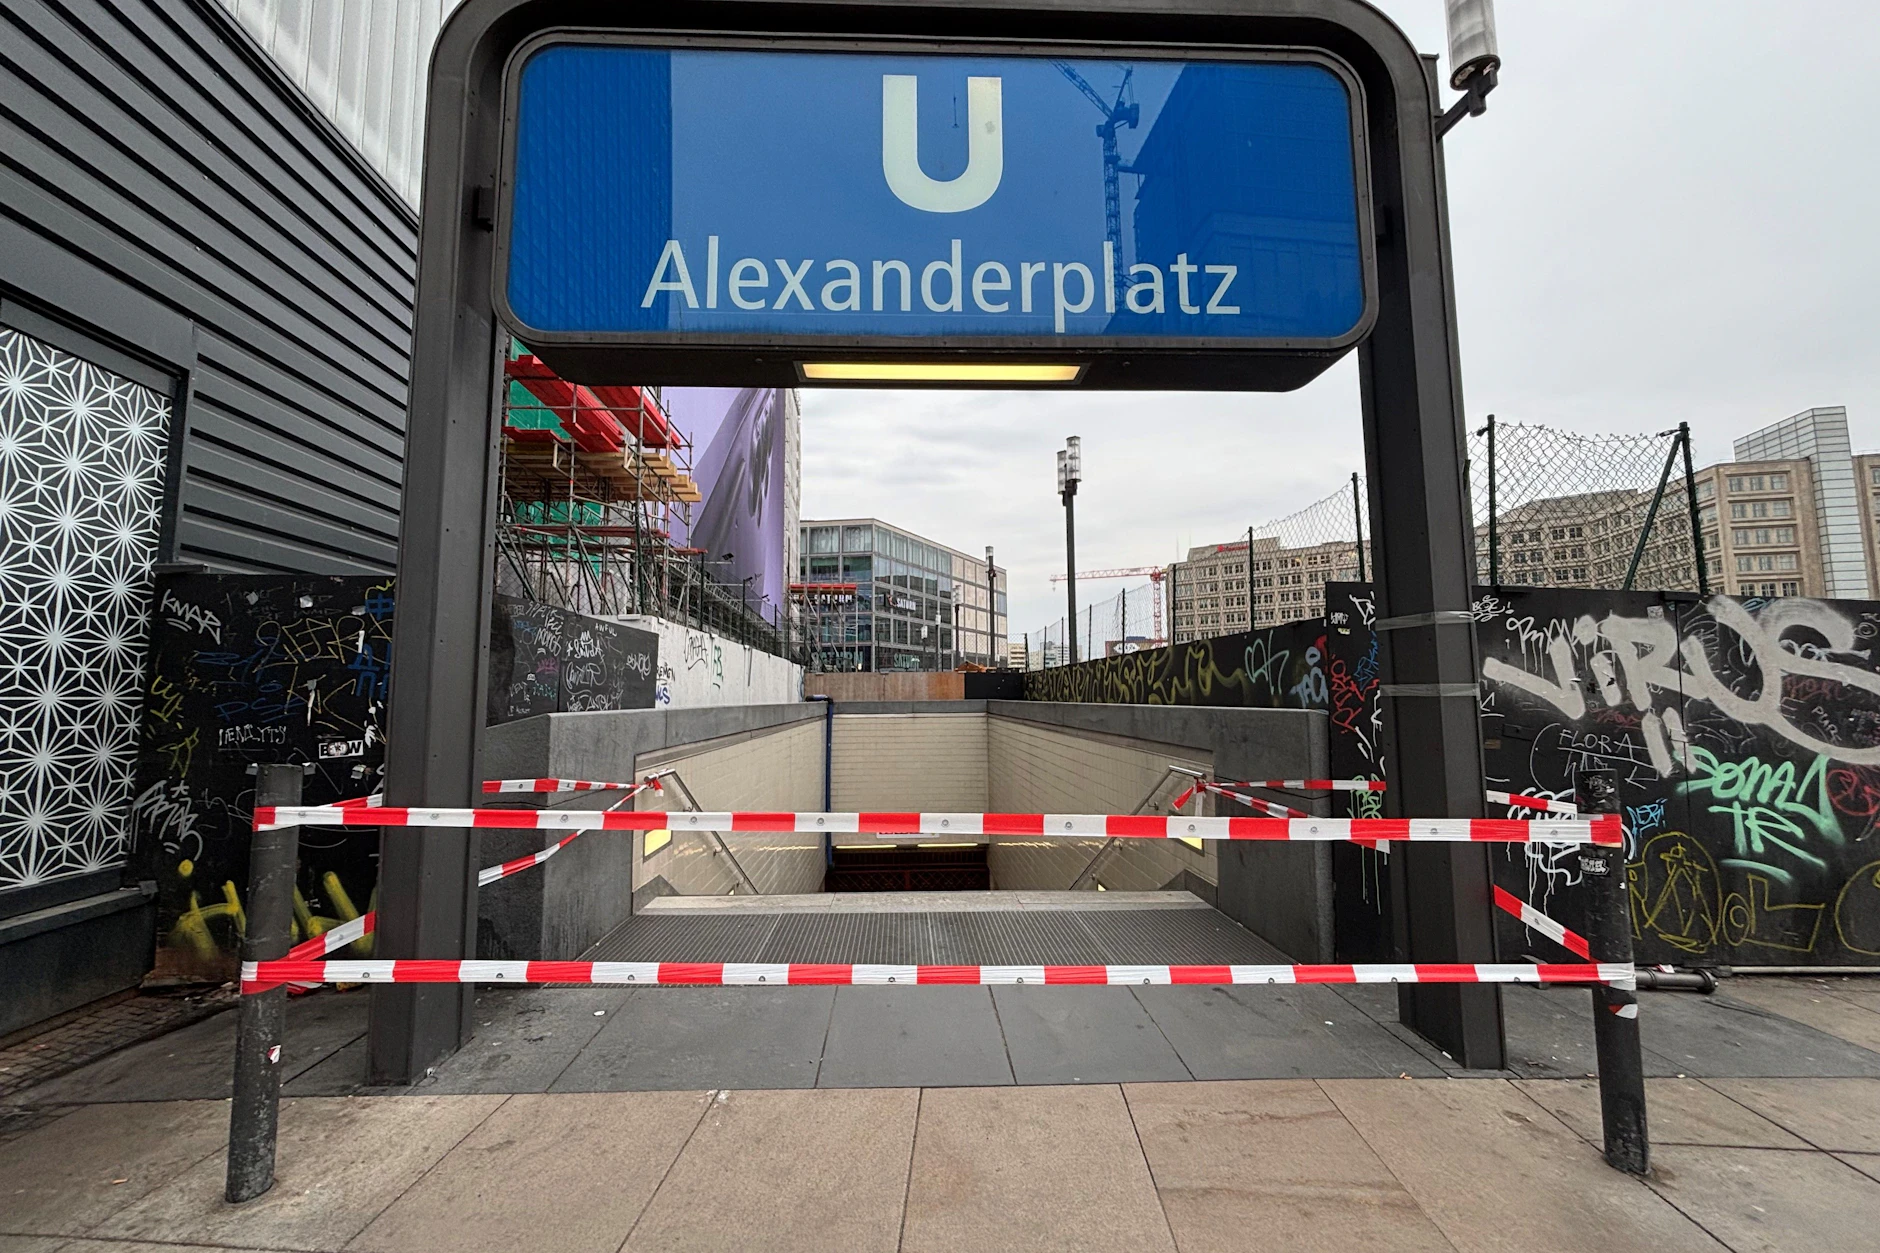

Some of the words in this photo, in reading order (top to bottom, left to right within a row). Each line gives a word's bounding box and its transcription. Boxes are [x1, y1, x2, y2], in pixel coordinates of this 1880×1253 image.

[883, 75, 1003, 213] U
[640, 235, 1241, 333] Alexanderplatz
[896, 597, 916, 611] SATURN
[1559, 729, 1648, 762] FLORA
